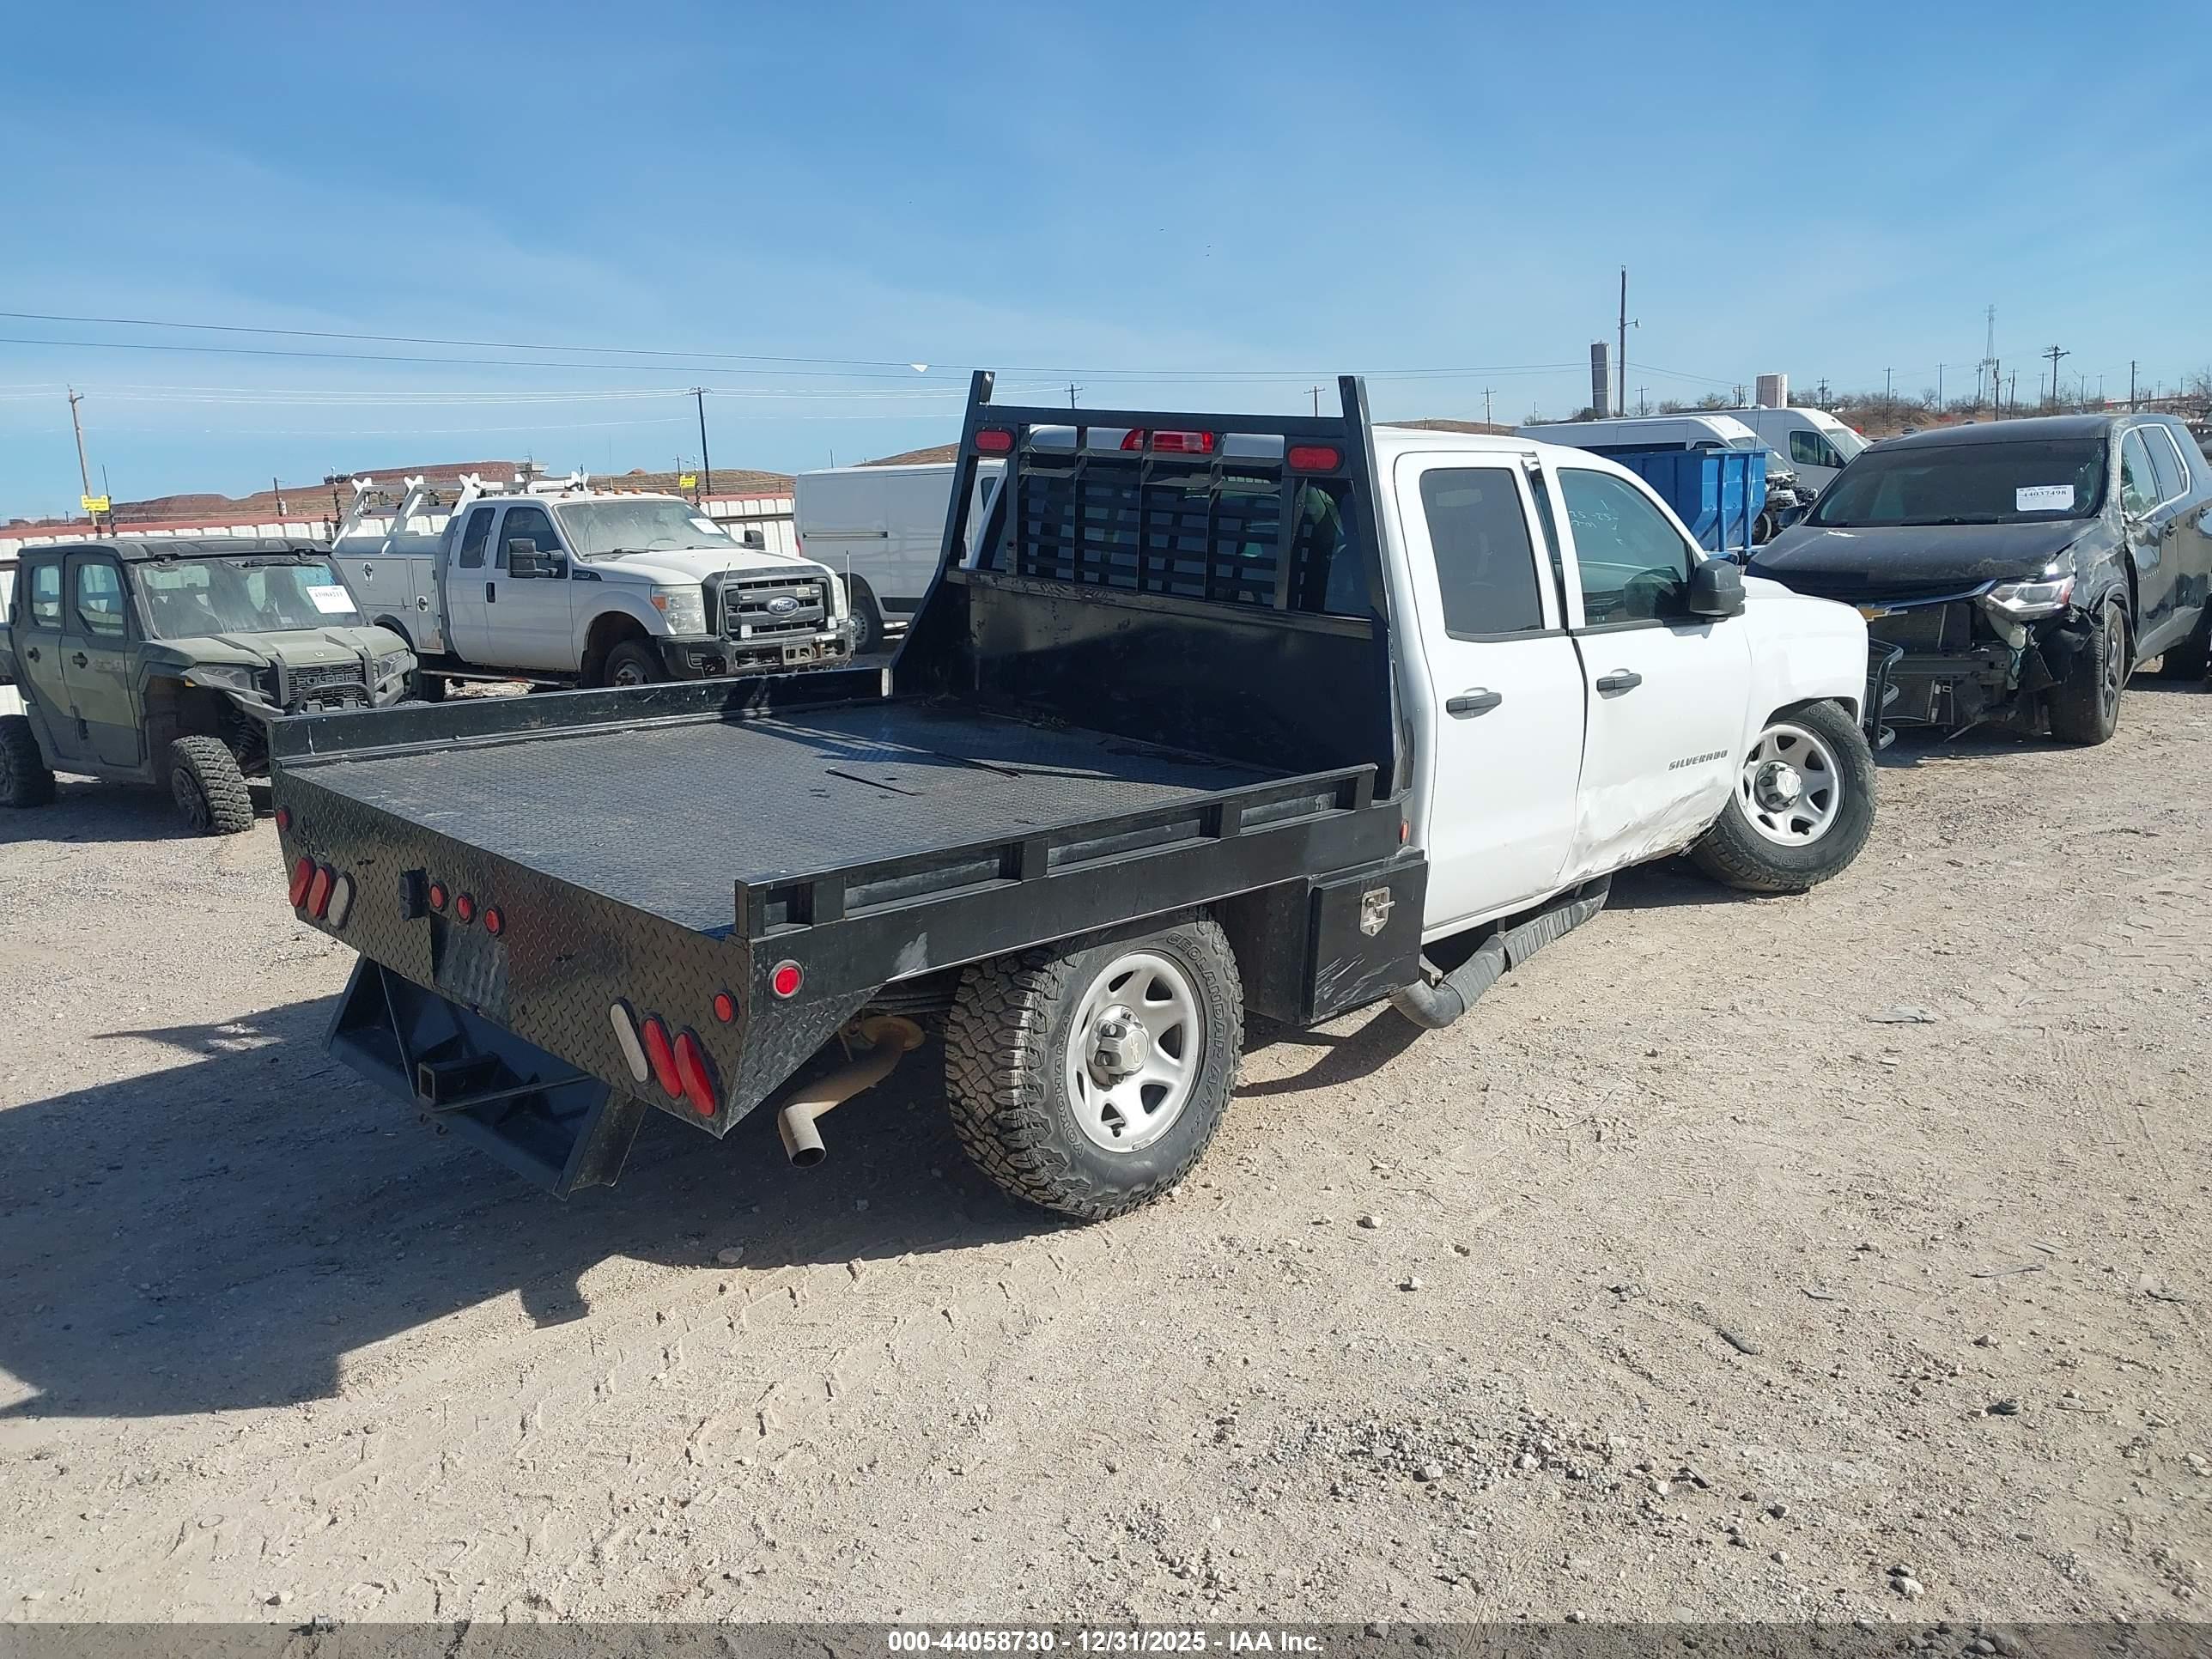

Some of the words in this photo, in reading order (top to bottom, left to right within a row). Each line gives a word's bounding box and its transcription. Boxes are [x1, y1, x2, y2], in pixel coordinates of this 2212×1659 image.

[1668, 749, 1729, 771] SILVERADO
[1166, 932, 1226, 1060] GEOLANDAR
[1054, 1015, 1085, 1158] YOKOHAMA
